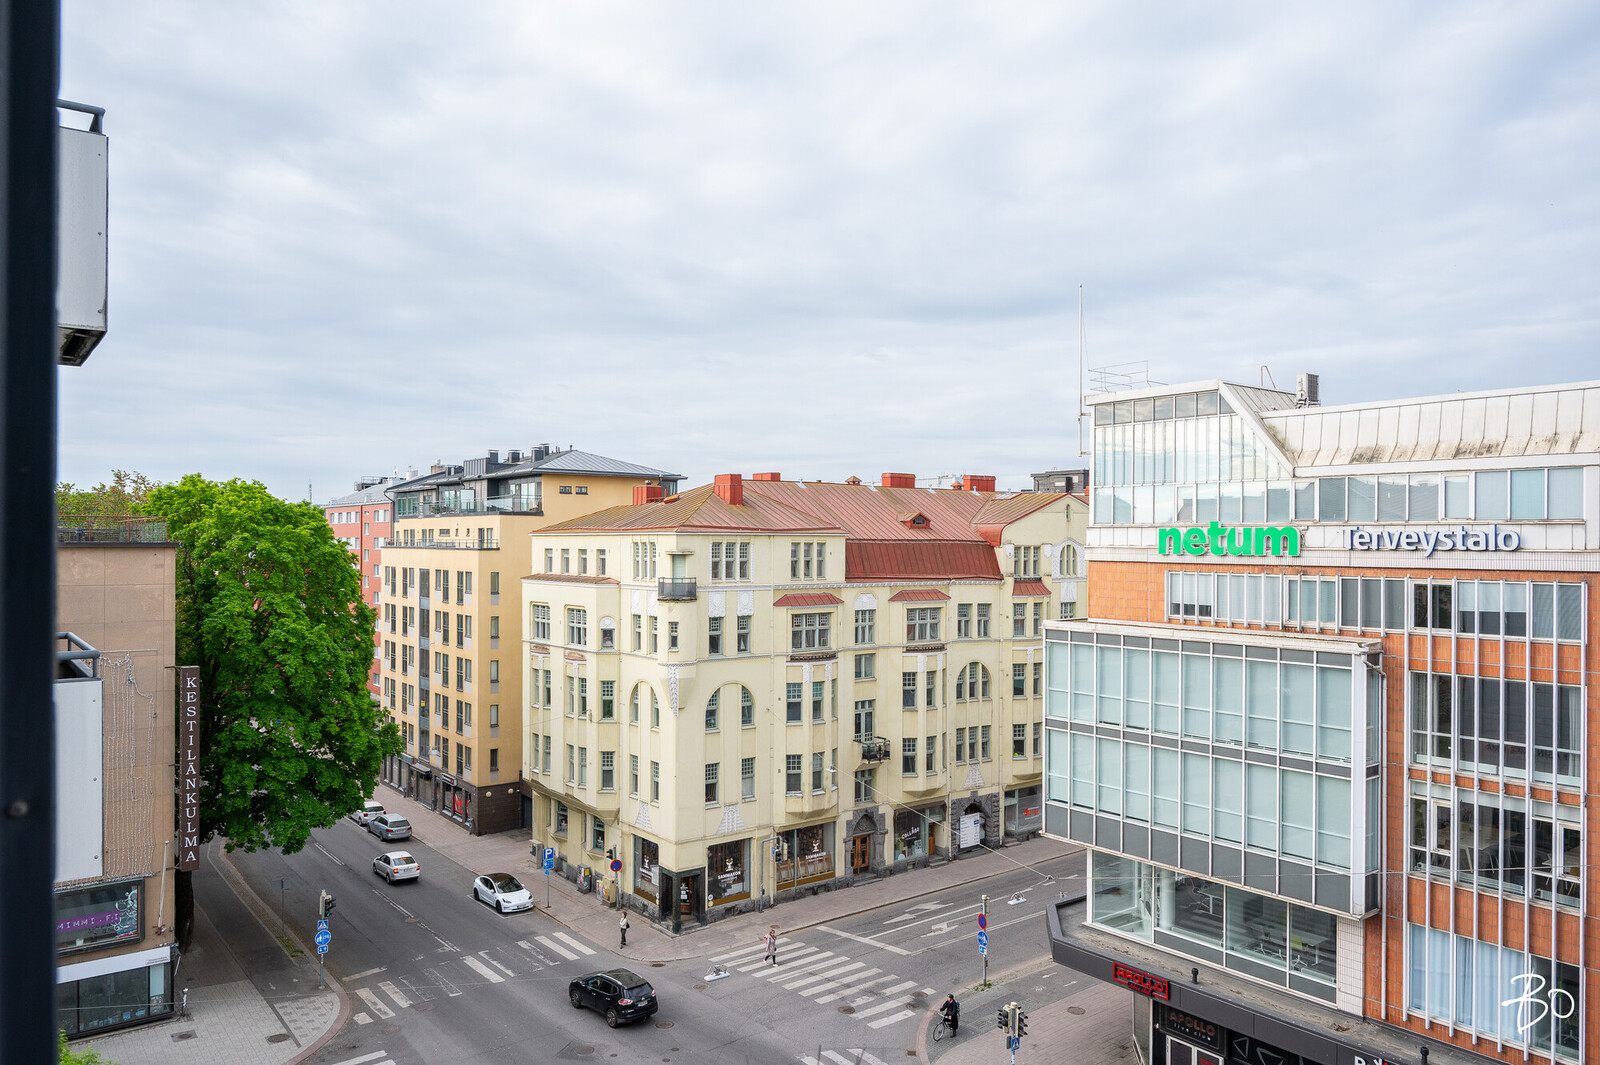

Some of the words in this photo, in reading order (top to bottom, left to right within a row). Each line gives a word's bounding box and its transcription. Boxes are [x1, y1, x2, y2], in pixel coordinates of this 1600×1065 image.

[1158, 521, 1301, 557] netum
[1339, 524, 1521, 558] Terveystalo
[184, 677, 198, 862] KESTILÄNKULMA
[545, 848, 553, 859] P
[1116, 968, 1165, 993] APOLLO
[1169, 1011, 1216, 1037] APOLLO
[1173, 1022, 1190, 1033] live
[1193, 1031, 1211, 1041] club
